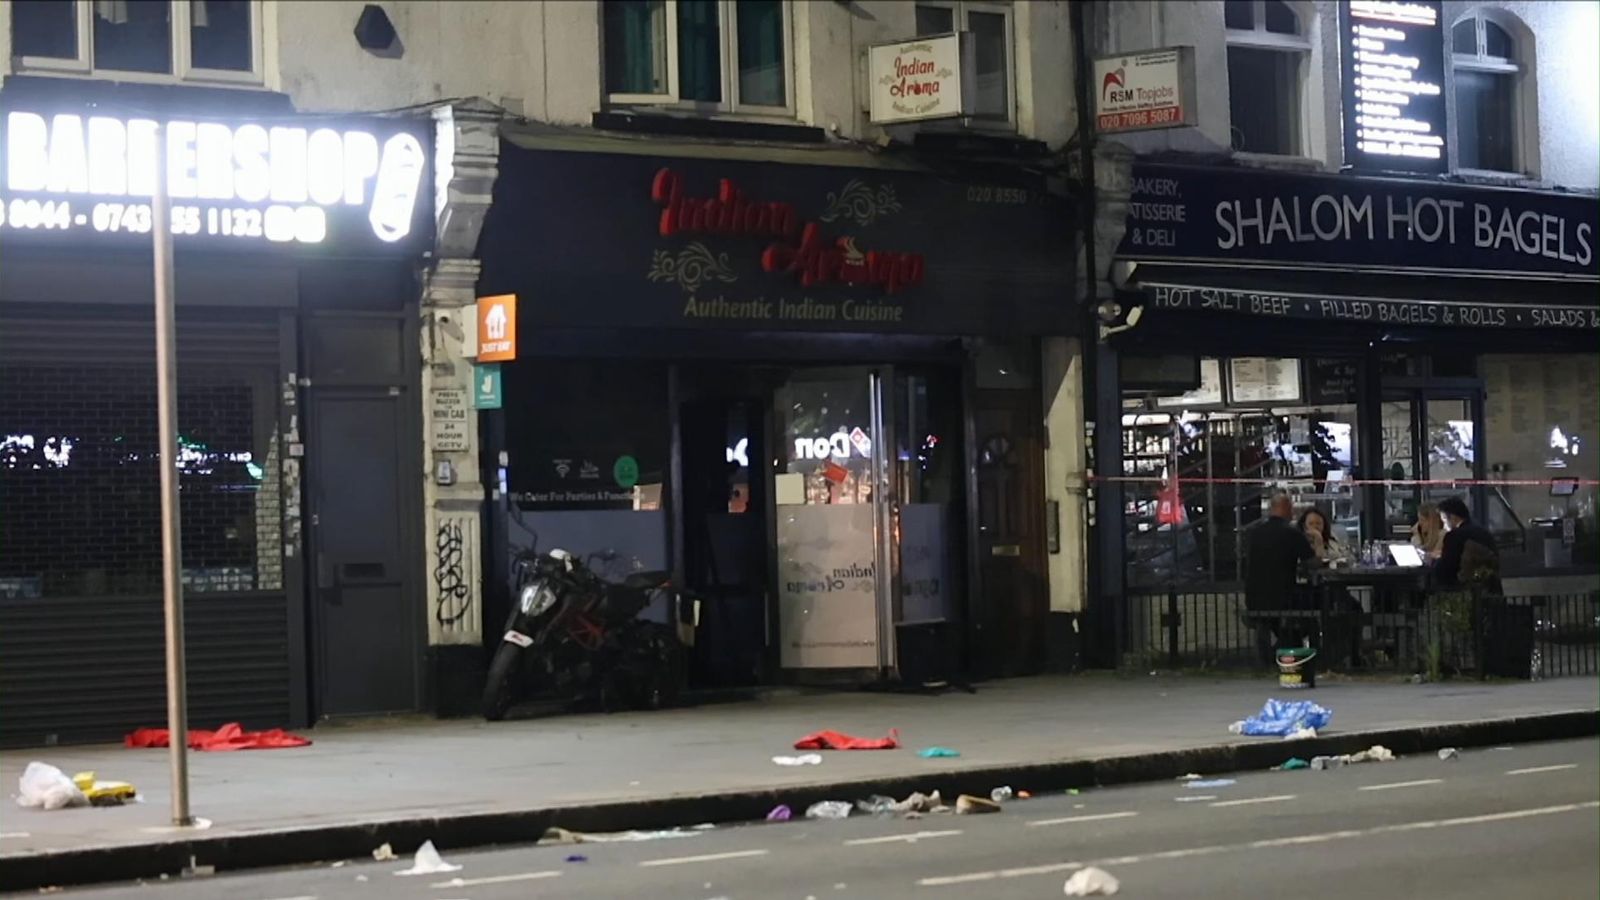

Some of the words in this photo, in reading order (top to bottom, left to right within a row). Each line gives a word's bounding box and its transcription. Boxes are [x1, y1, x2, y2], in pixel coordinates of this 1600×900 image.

[894, 56, 935, 79] Indian
[889, 77, 940, 98] Aroma
[1110, 89, 1134, 103] RSM
[1136, 86, 1174, 101] Topjobs
[1100, 116, 1120, 129] 020
[1122, 112, 1148, 126] 7096
[1150, 109, 1176, 122] 5087
[651, 166, 797, 238] Indian
[1127, 202, 1187, 223] ATISSERIE
[1132, 227, 1143, 245] &
[1146, 228, 1176, 247] DELI
[1216, 194, 1374, 249] SHALOM
[1387, 197, 1465, 245] HOT
[1474, 203, 1593, 266] BAGELS
[760, 222, 928, 295] Aroma
[684, 296, 772, 320] Authentic
[779, 297, 836, 321] Indian
[842, 299, 903, 321] Cuisine
[1155, 288, 1196, 307] HOT
[1200, 288, 1245, 310] SALT
[1249, 294, 1292, 315] BEEF
[1320, 300, 1373, 319] FILLED
[1378, 303, 1437, 323] BAGELS
[1443, 306, 1454, 324] &
[1460, 307, 1506, 326] ROLLS
[1531, 309, 1586, 326] SALADS
